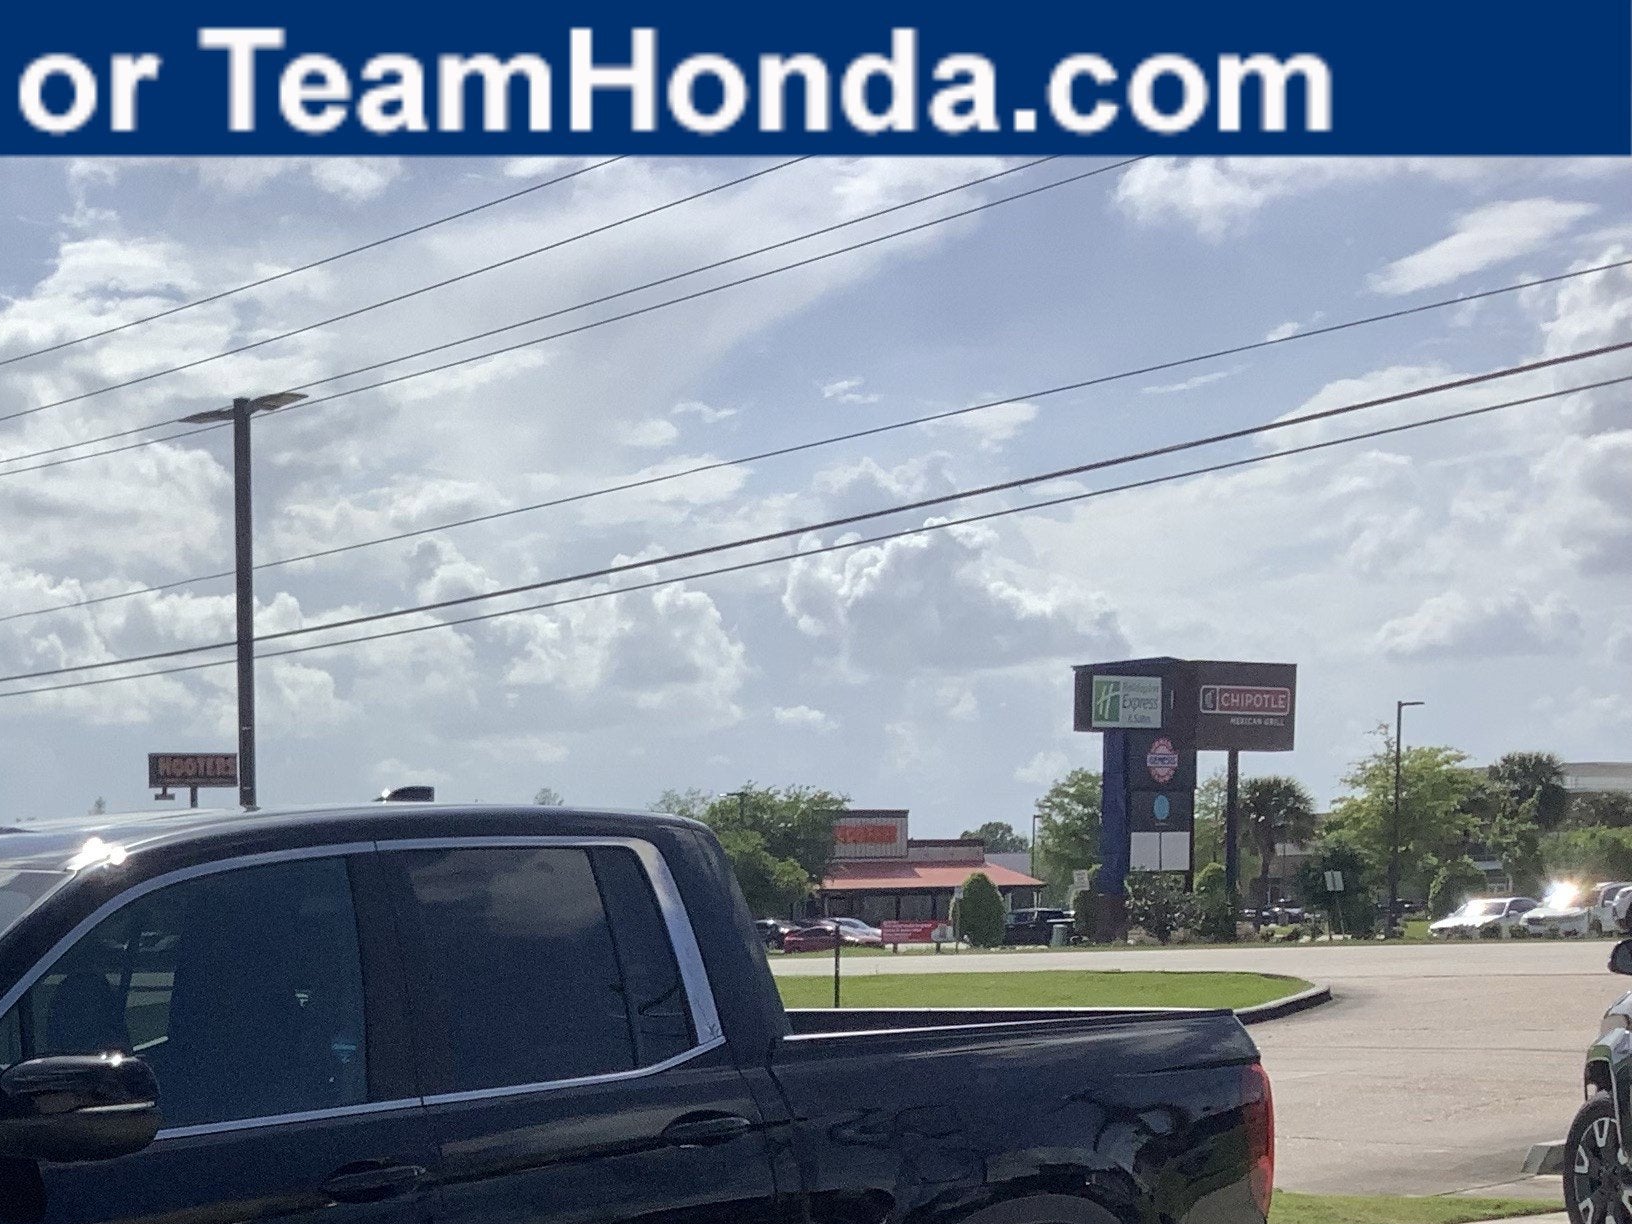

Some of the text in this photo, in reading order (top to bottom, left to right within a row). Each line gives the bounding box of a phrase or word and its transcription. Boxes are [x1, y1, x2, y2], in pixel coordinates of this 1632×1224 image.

[1122, 693, 1158, 711] Express
[1221, 692, 1287, 709] CHIPOTLE
[1230, 717, 1284, 726] MEXICAN GRILL
[159, 757, 235, 776] HOOTERS
